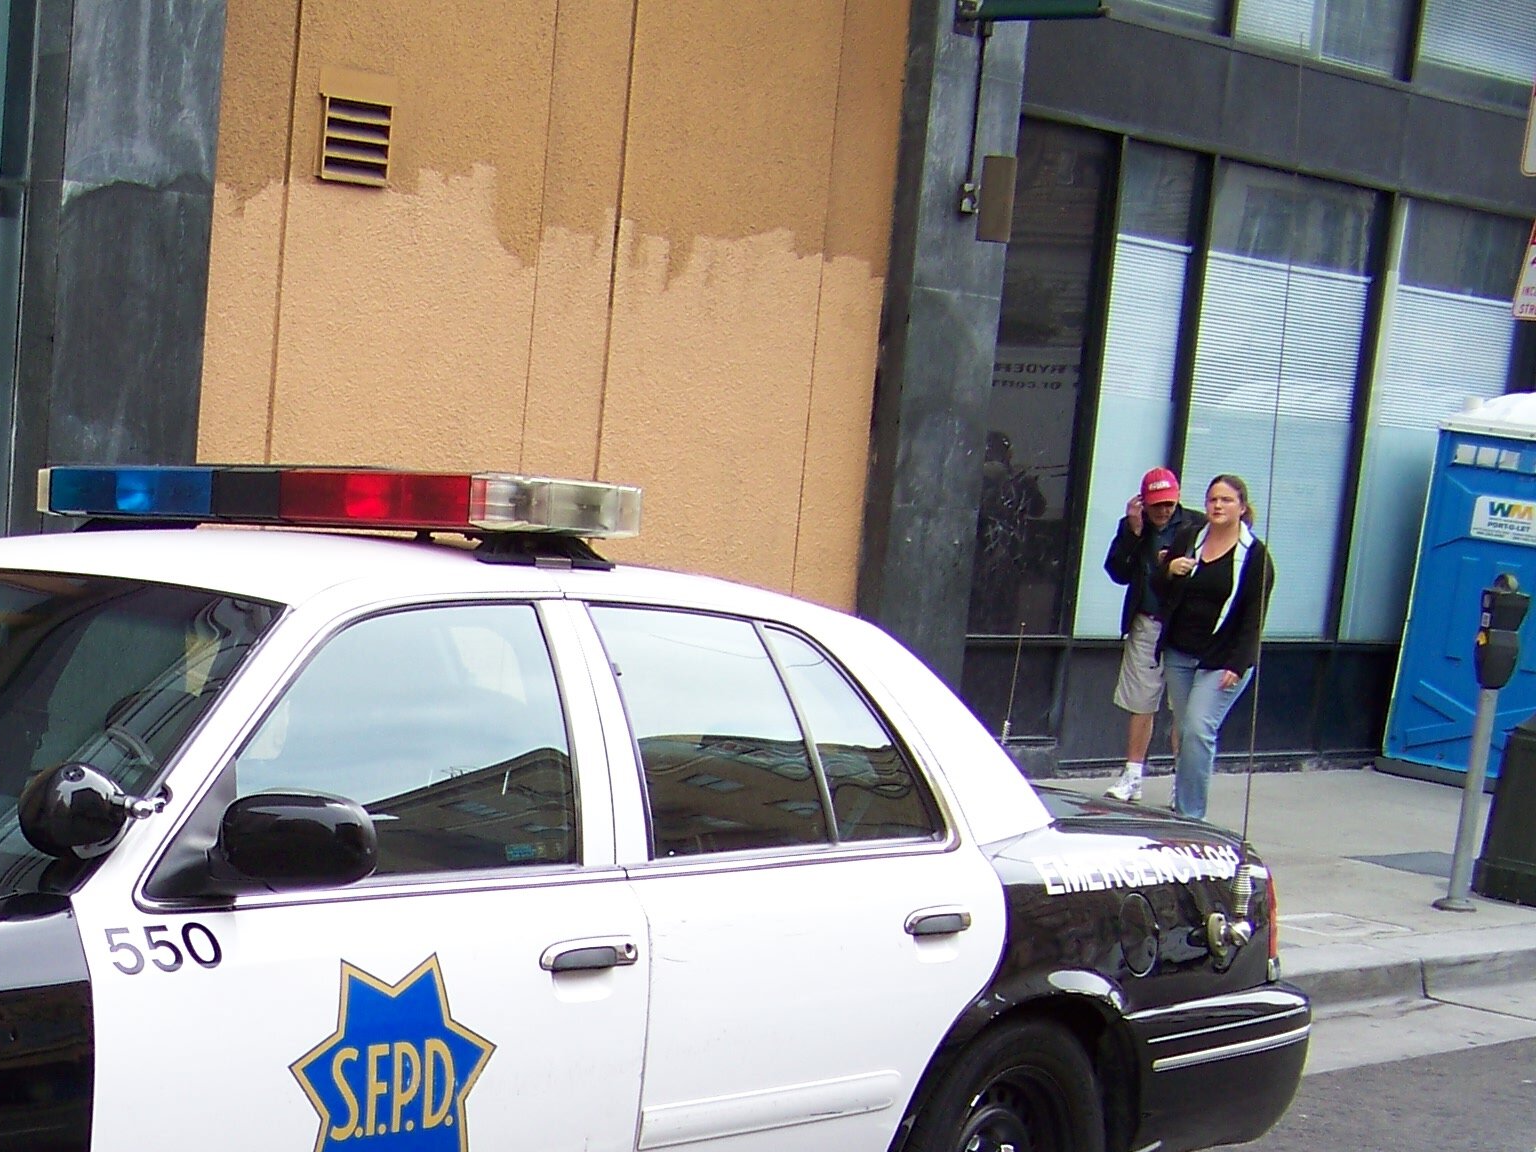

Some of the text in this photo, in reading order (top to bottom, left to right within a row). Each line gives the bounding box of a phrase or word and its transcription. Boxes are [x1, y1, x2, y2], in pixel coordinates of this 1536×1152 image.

[1519, 304, 1536, 315] STR
[1489, 501, 1534, 520] WM
[104, 922, 223, 976] 550
[330, 1038, 455, 1141] S.F.P.D.
